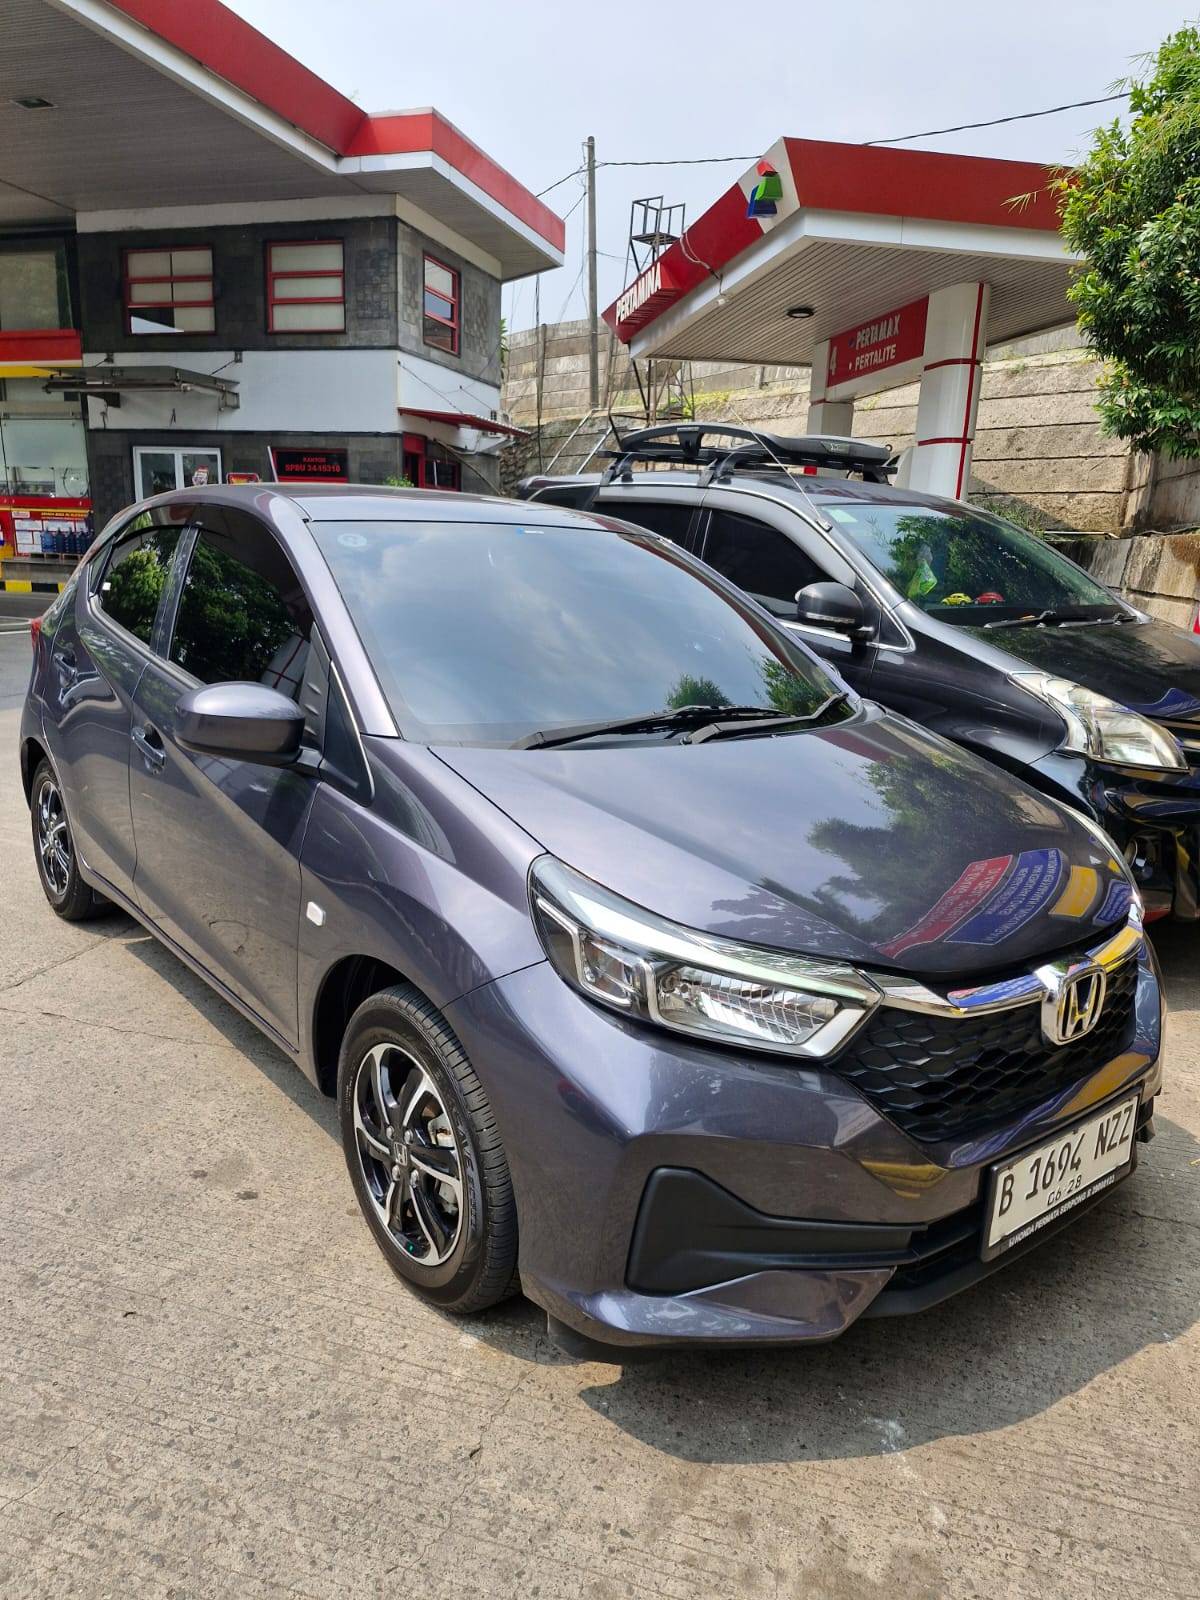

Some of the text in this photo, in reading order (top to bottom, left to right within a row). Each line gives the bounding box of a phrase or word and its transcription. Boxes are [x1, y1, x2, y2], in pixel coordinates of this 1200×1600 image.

[616, 262, 661, 326] PERTAMINA
[856, 314, 900, 350] PERTAMAX
[830, 346, 837, 376] 4
[855, 344, 897, 371] PERTALITE
[998, 1104, 1134, 1218] B 1694 NZZ
